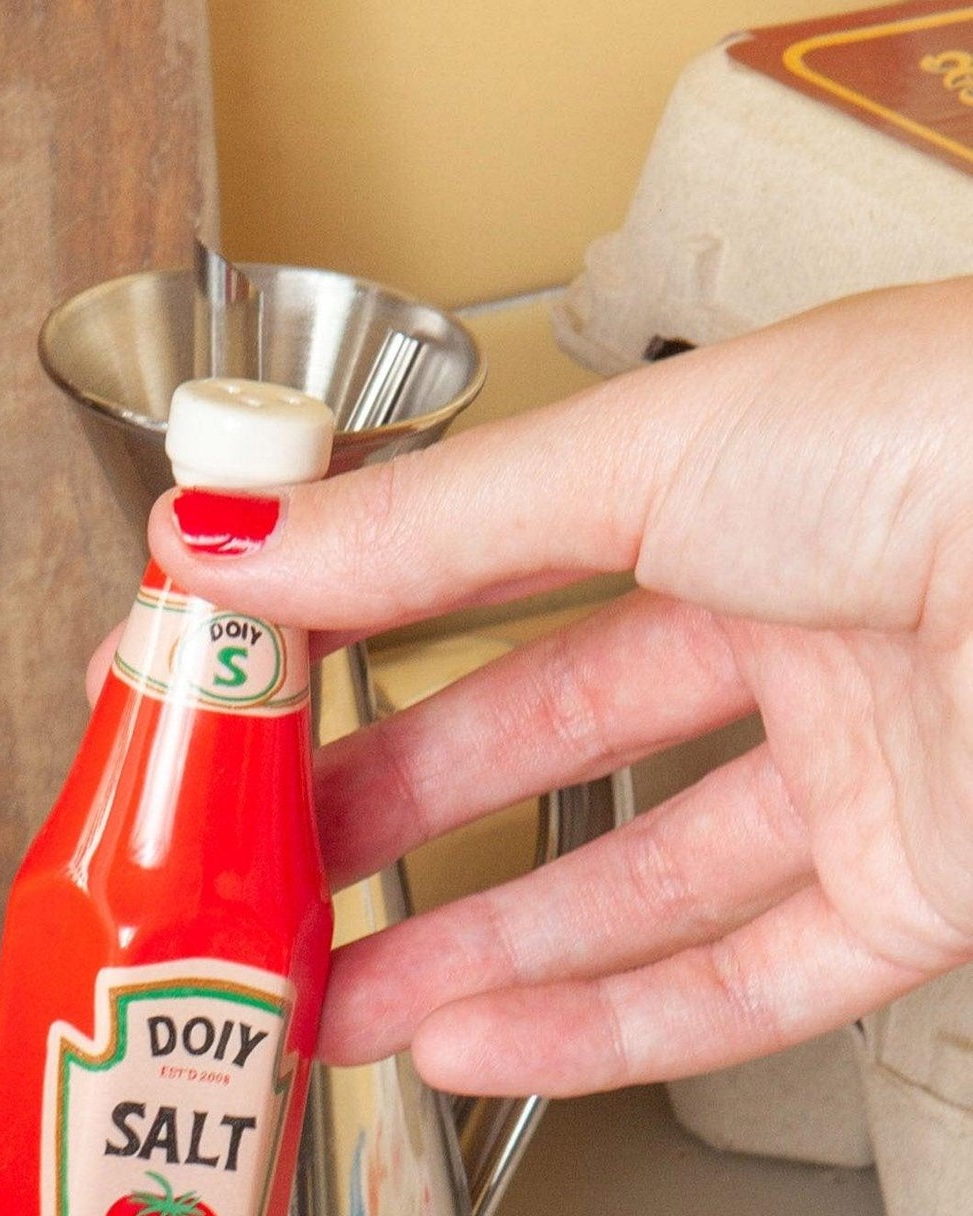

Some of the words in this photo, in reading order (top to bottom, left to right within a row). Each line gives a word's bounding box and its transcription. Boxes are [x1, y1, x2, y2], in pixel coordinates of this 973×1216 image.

[210, 620, 263, 646] DOIY
[213, 646, 248, 687] S
[147, 1015, 269, 1068] DOIY
[104, 1100, 257, 1171] SALT
